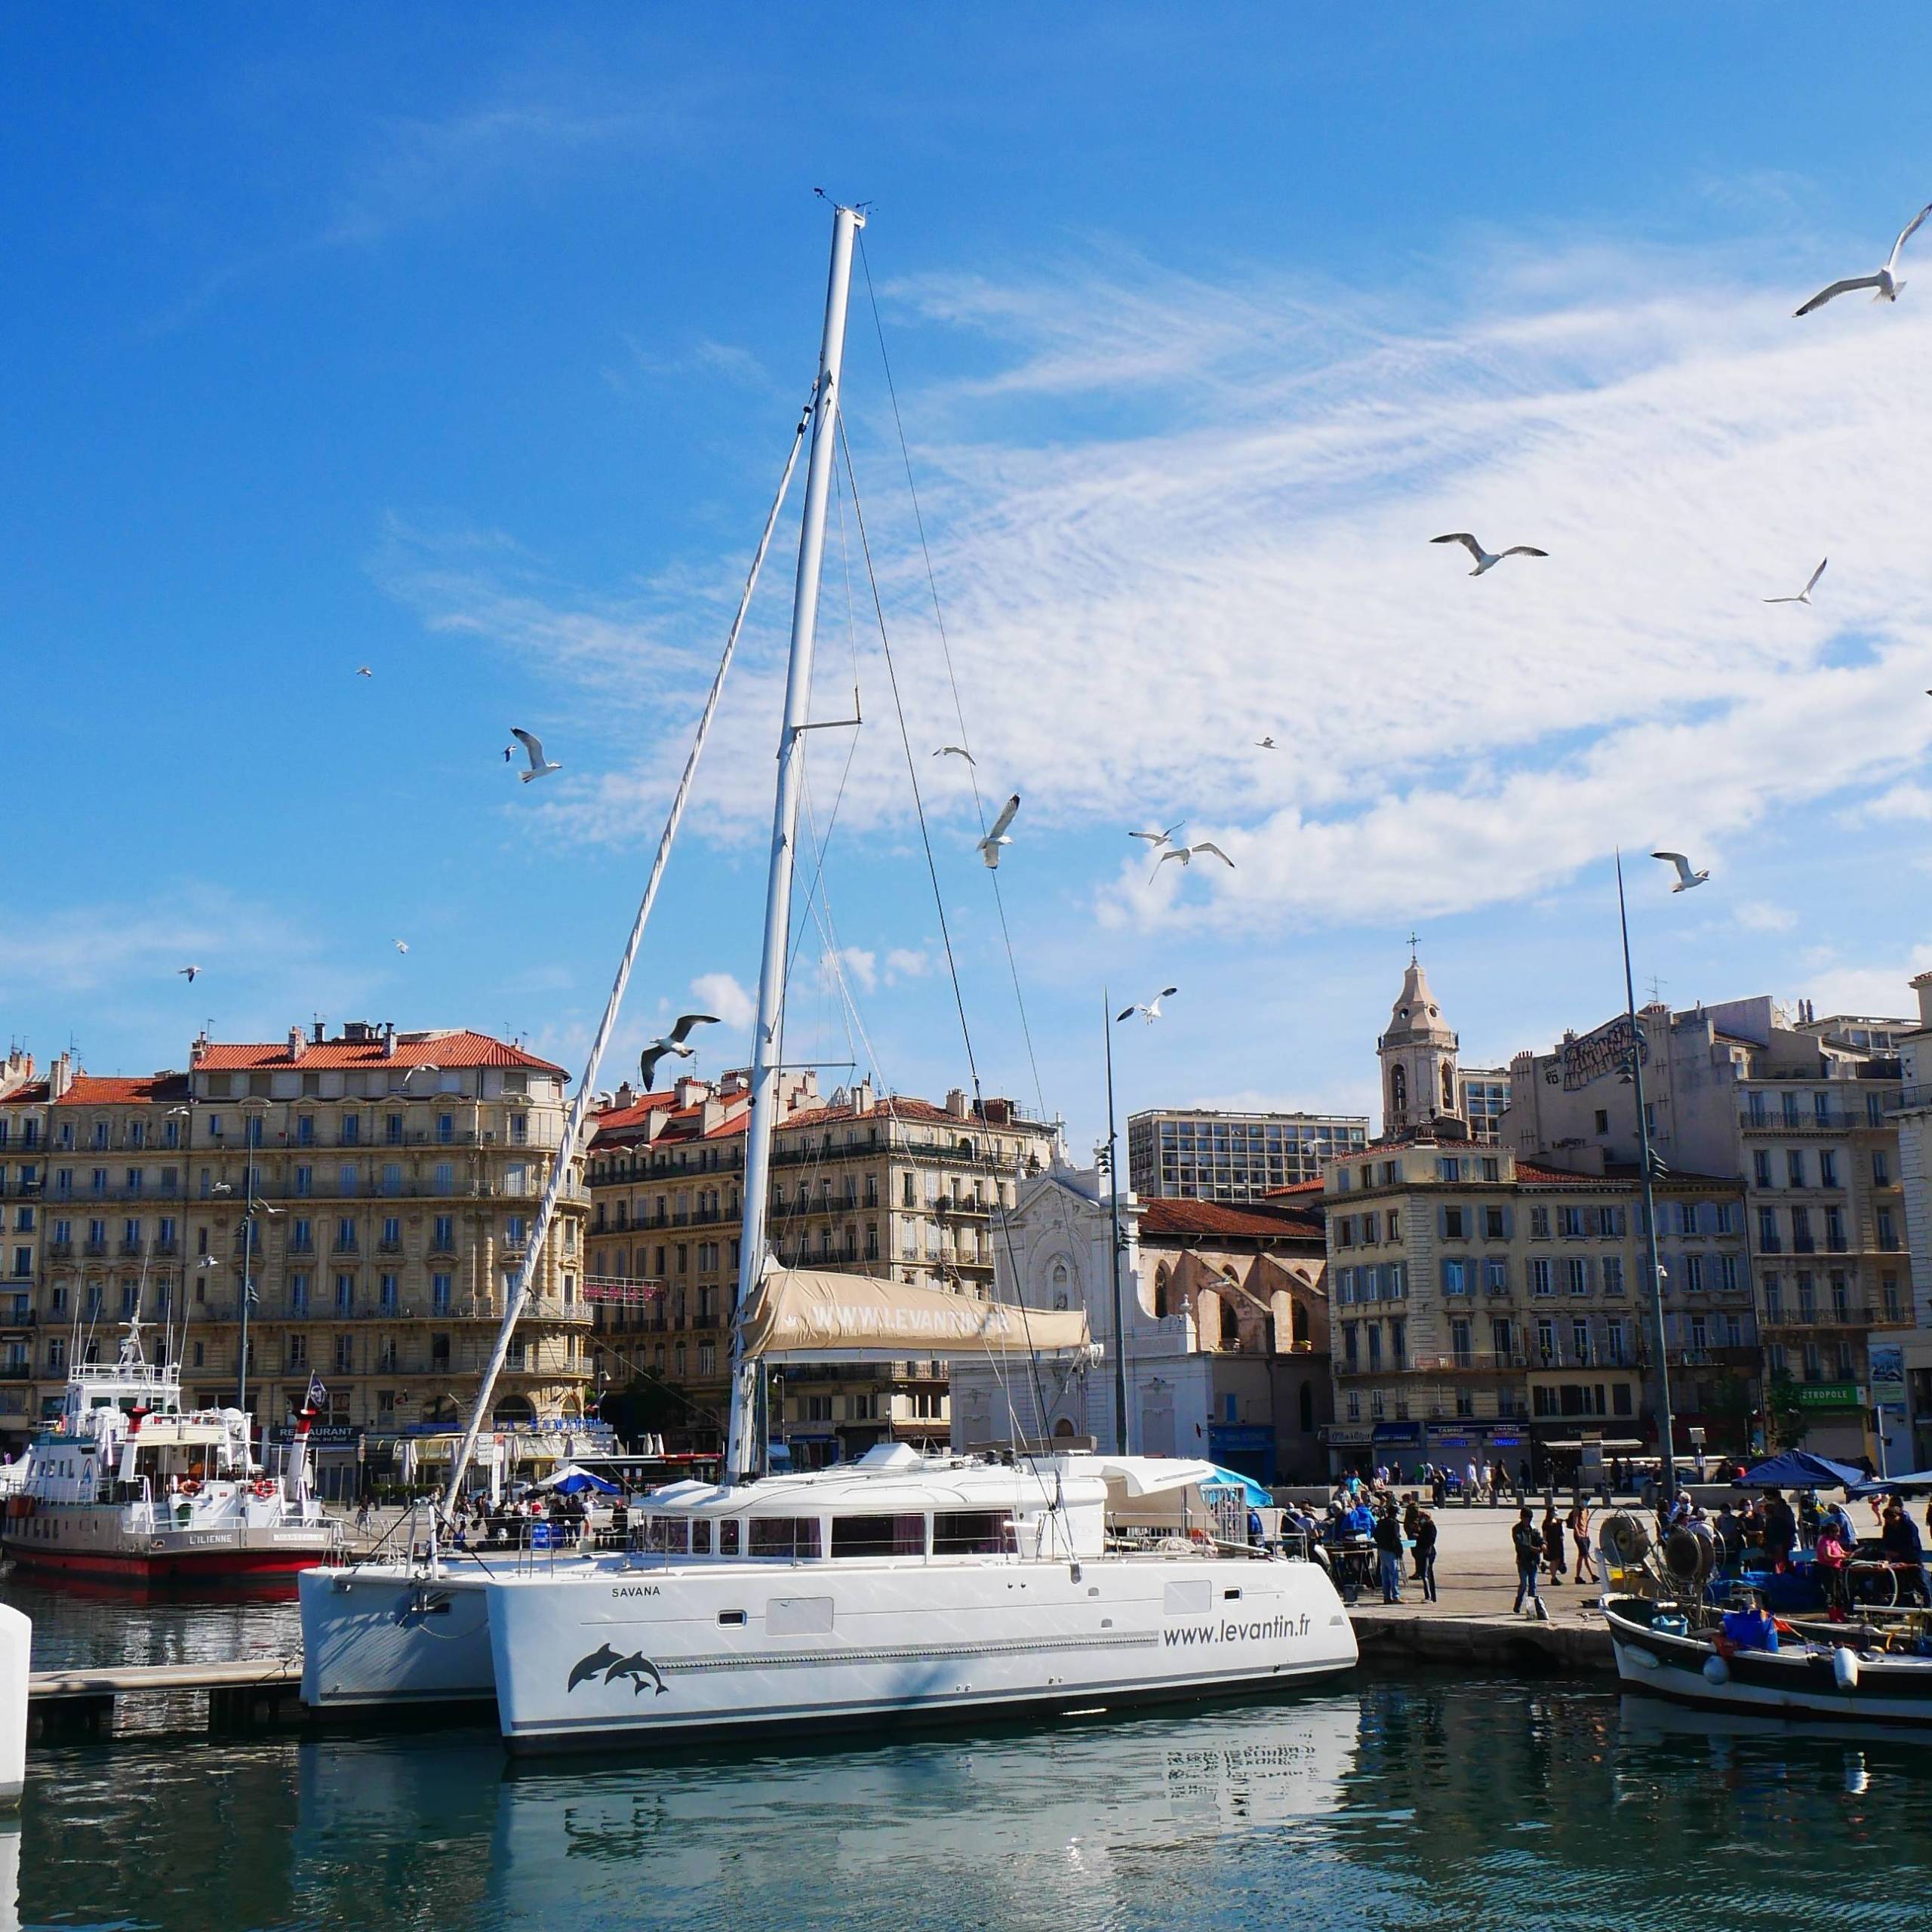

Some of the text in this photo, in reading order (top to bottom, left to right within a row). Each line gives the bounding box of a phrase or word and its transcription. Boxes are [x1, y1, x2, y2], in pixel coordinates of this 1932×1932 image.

[279, 1428, 354, 1436] REAURANT
[189, 1534, 232, 1545] L'ILIENNE
[611, 1586, 660, 1598] SAVANA
[1163, 1613, 1311, 1647] www.levantin.fr
